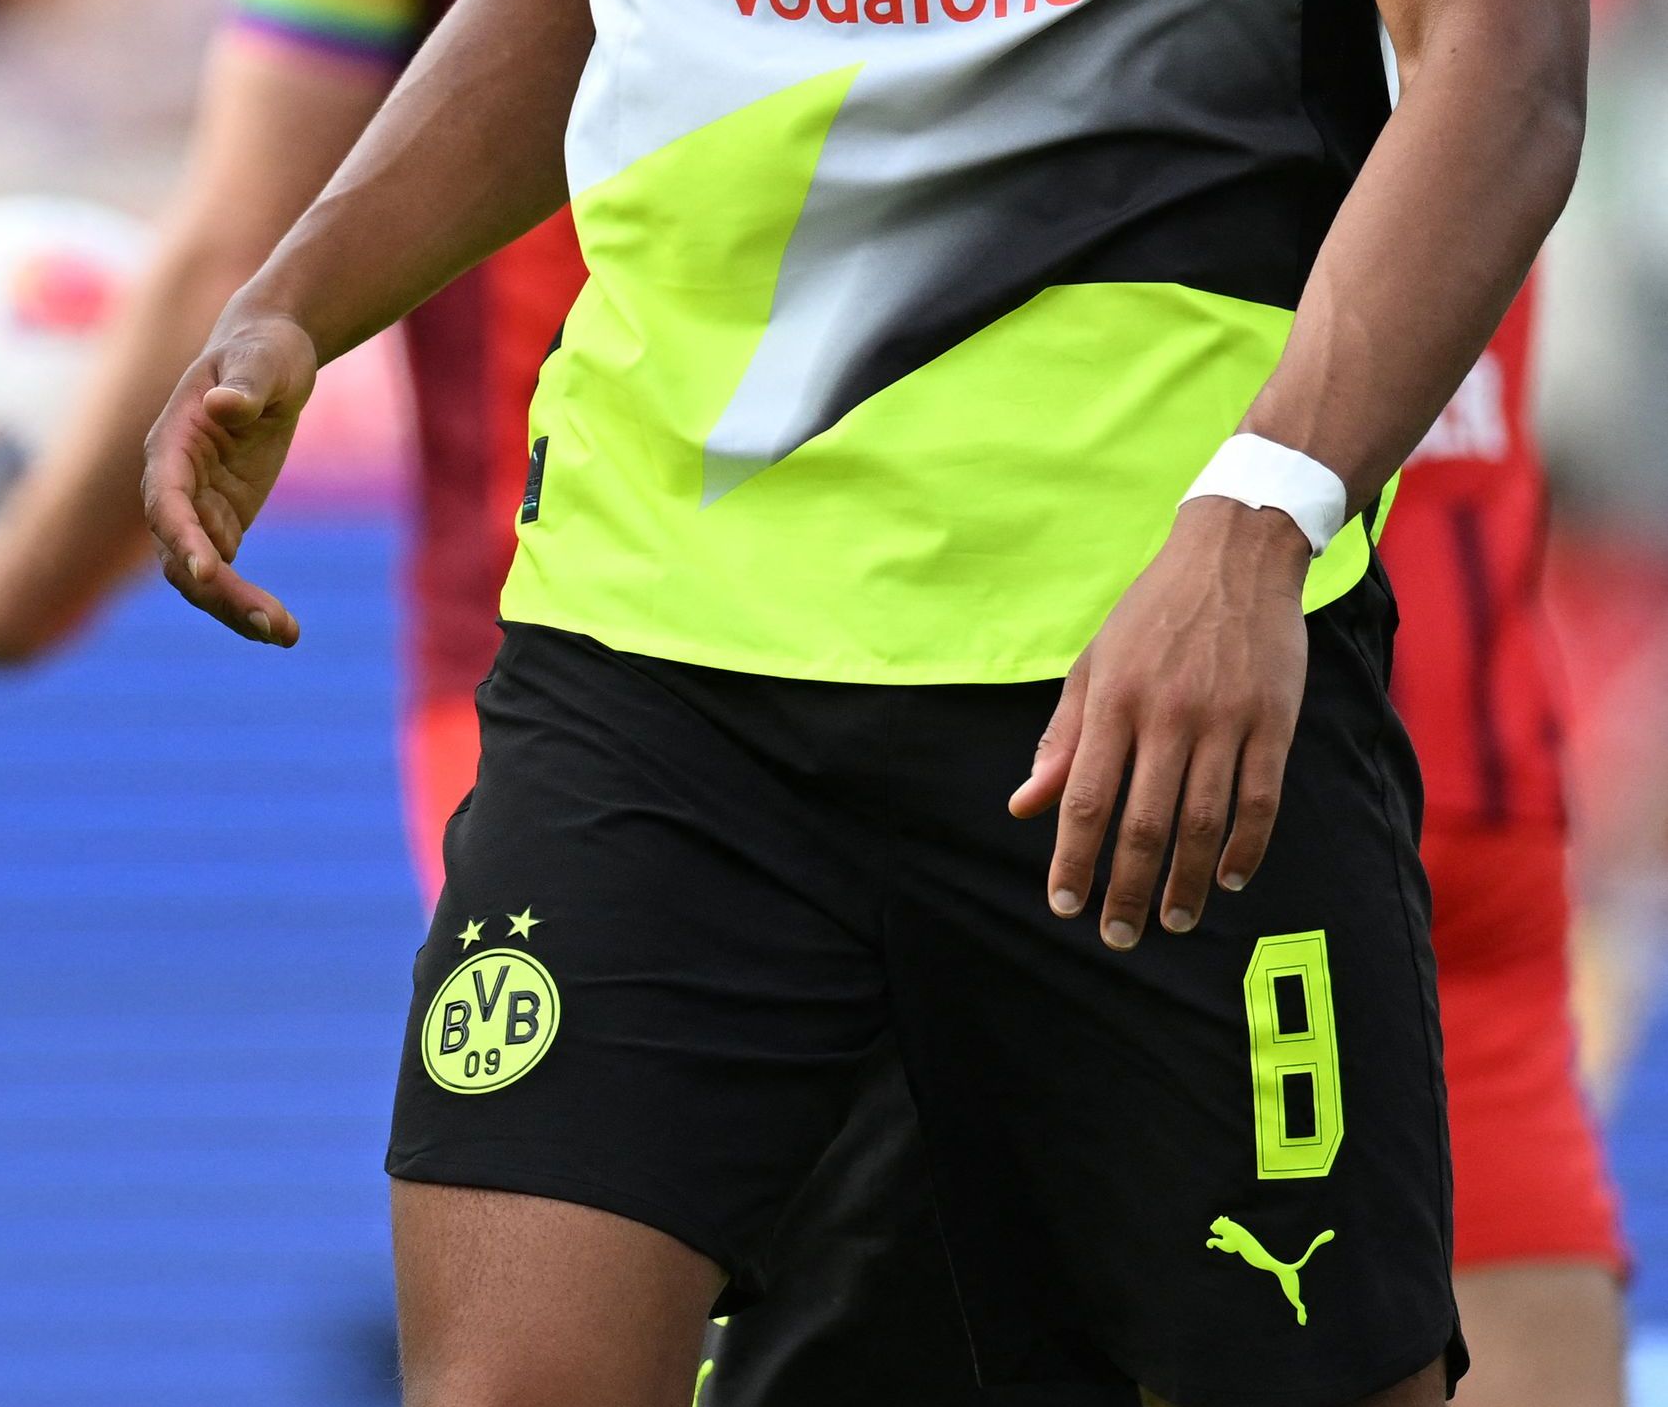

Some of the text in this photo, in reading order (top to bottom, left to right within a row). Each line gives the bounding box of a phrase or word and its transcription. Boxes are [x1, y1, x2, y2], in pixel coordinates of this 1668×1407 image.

[439, 965, 541, 1056] BVB
[1243, 929, 1344, 1180] 8
[463, 1047, 501, 1079] 09
